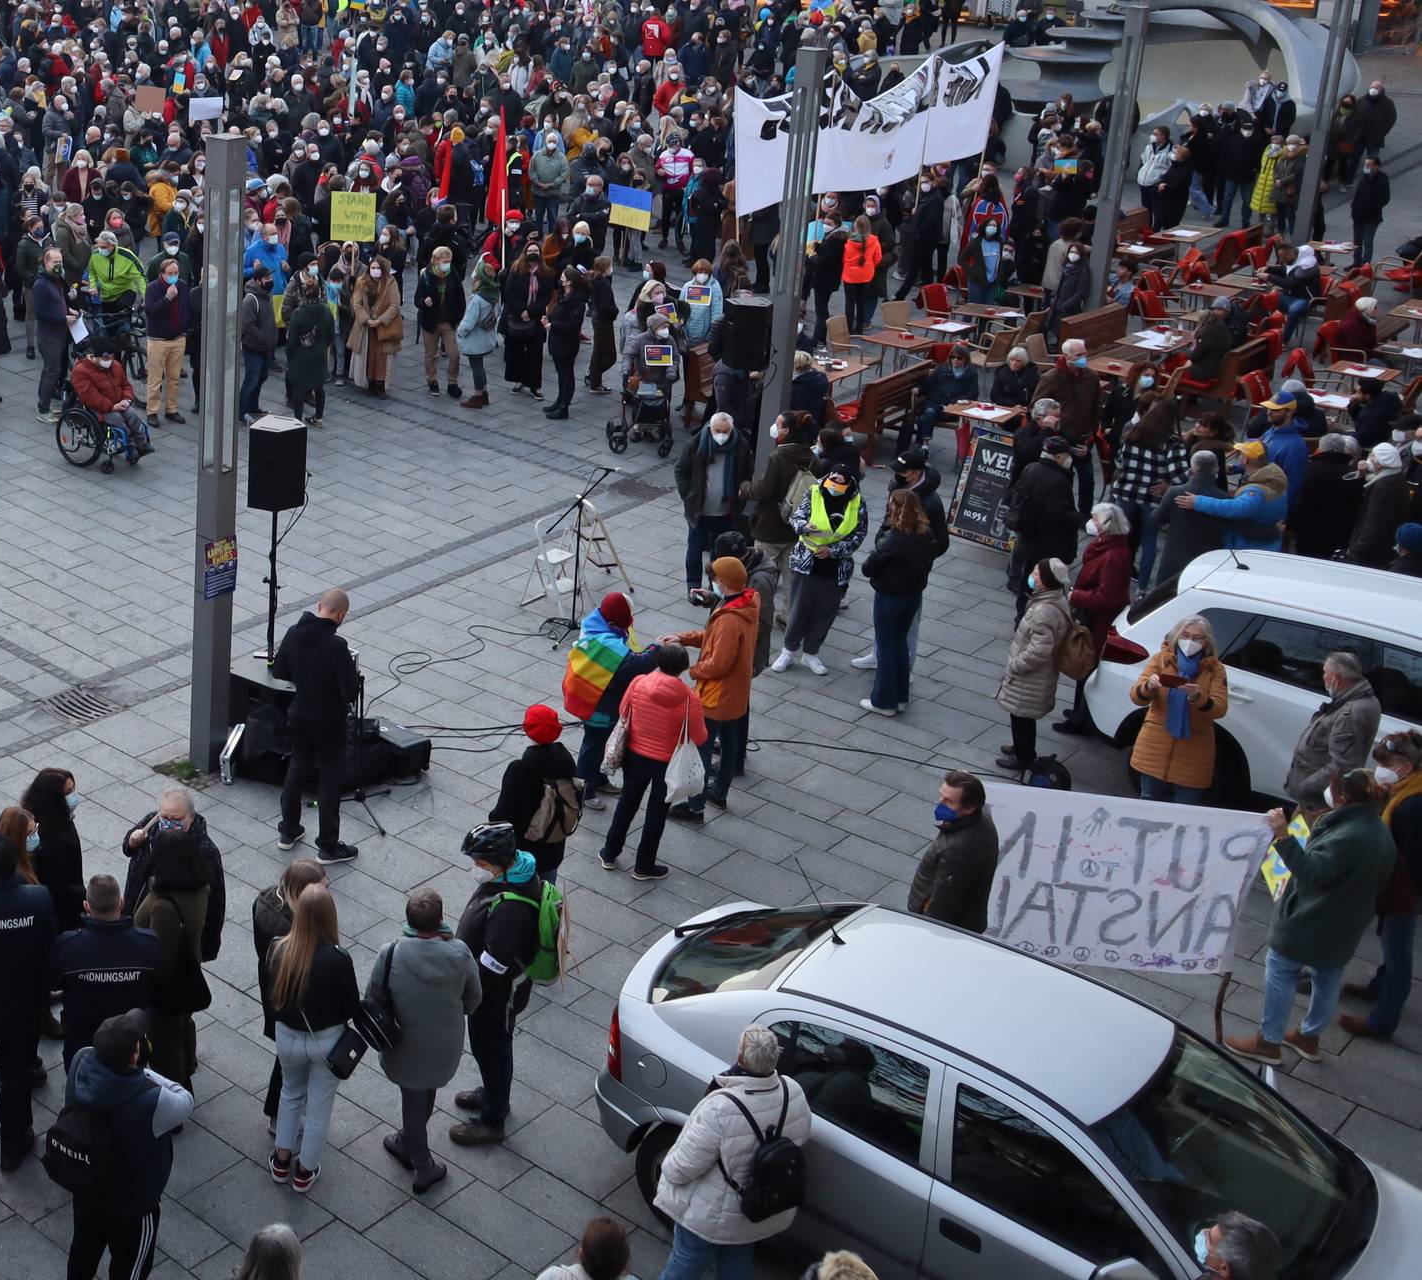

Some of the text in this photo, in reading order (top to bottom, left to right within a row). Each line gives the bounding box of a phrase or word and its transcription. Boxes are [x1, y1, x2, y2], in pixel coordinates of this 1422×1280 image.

[338, 193, 372, 206] STAND
[344, 210, 368, 222] WITH
[981, 448, 1014, 471] WEI
[977, 464, 1011, 480] SCHMECK
[51, 1138, 91, 1165] O'NEILL
